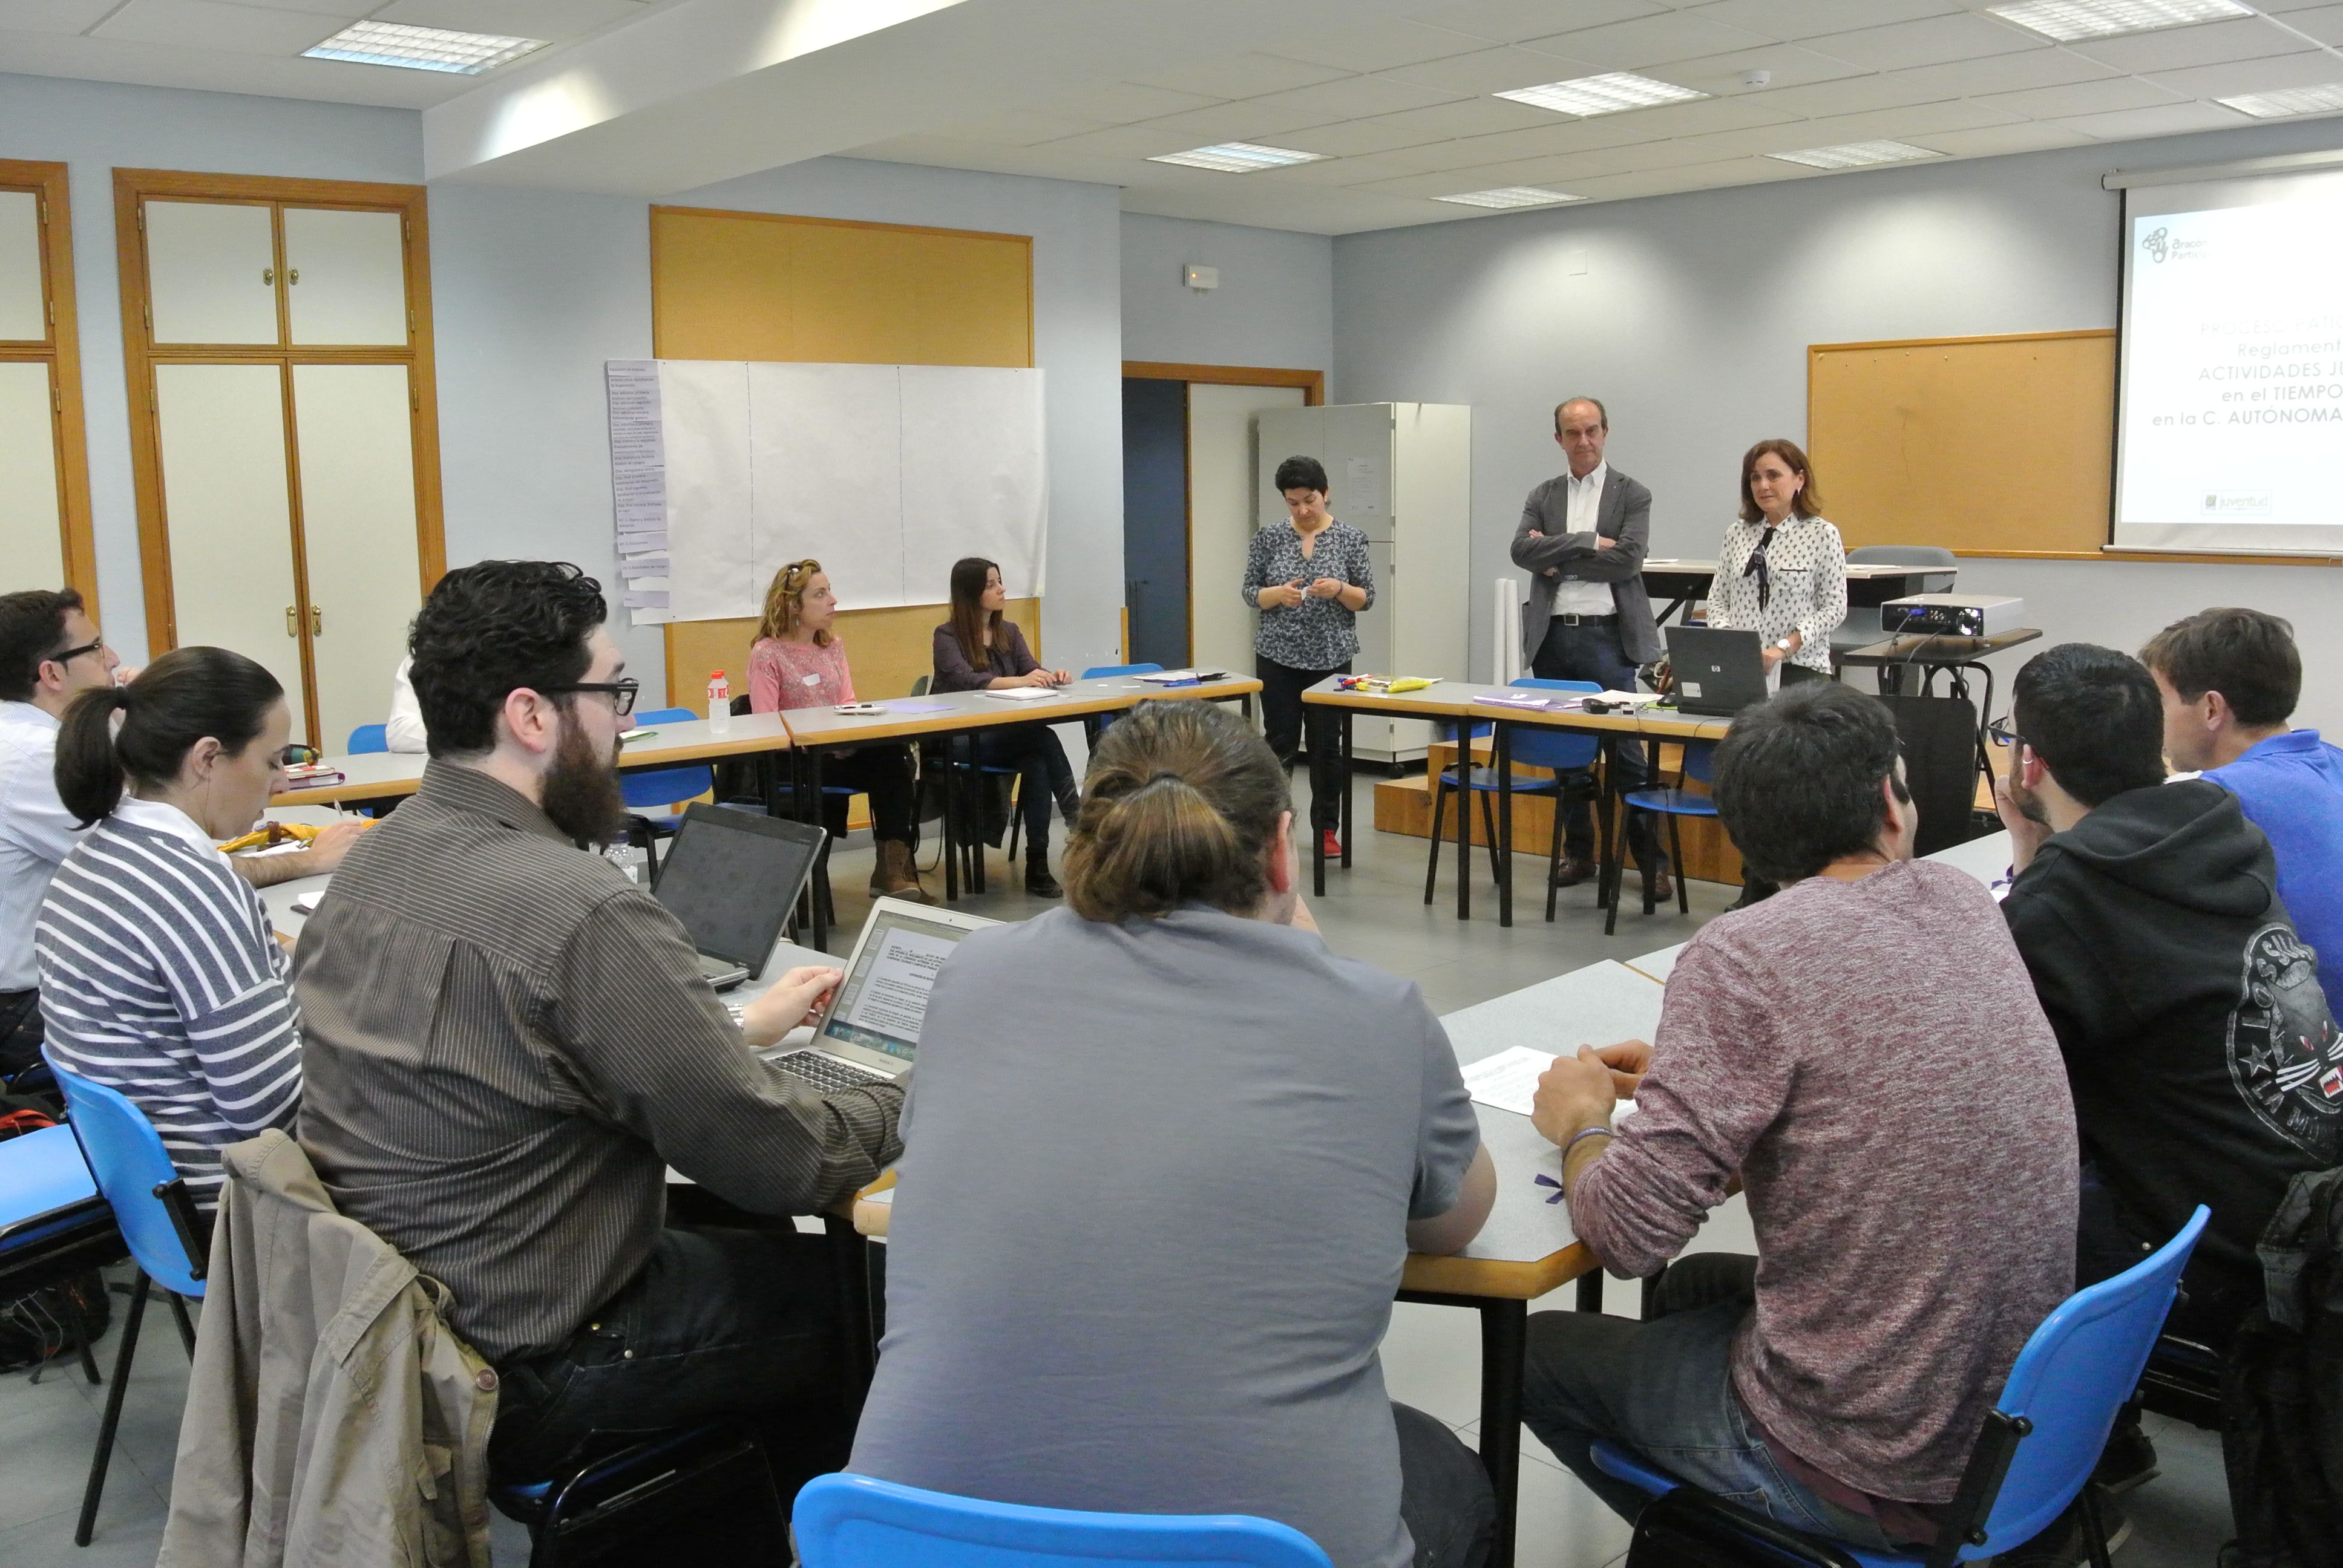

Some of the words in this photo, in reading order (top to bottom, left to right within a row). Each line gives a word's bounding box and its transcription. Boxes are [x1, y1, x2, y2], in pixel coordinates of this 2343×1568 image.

[2171, 249, 2213, 261] Particip
[2200, 318, 2286, 337] PROCESO
[2198, 361, 2322, 381] ACTIVIDADES
[2221, 391, 2244, 402] en
[2250, 387, 2266, 401] el
[2273, 383, 2343, 400] TIEMPO
[2152, 416, 2174, 426] en
[2180, 411, 2197, 425] la
[2202, 410, 2220, 425] C.
[2227, 404, 2343, 425] AUTÓNOMA
